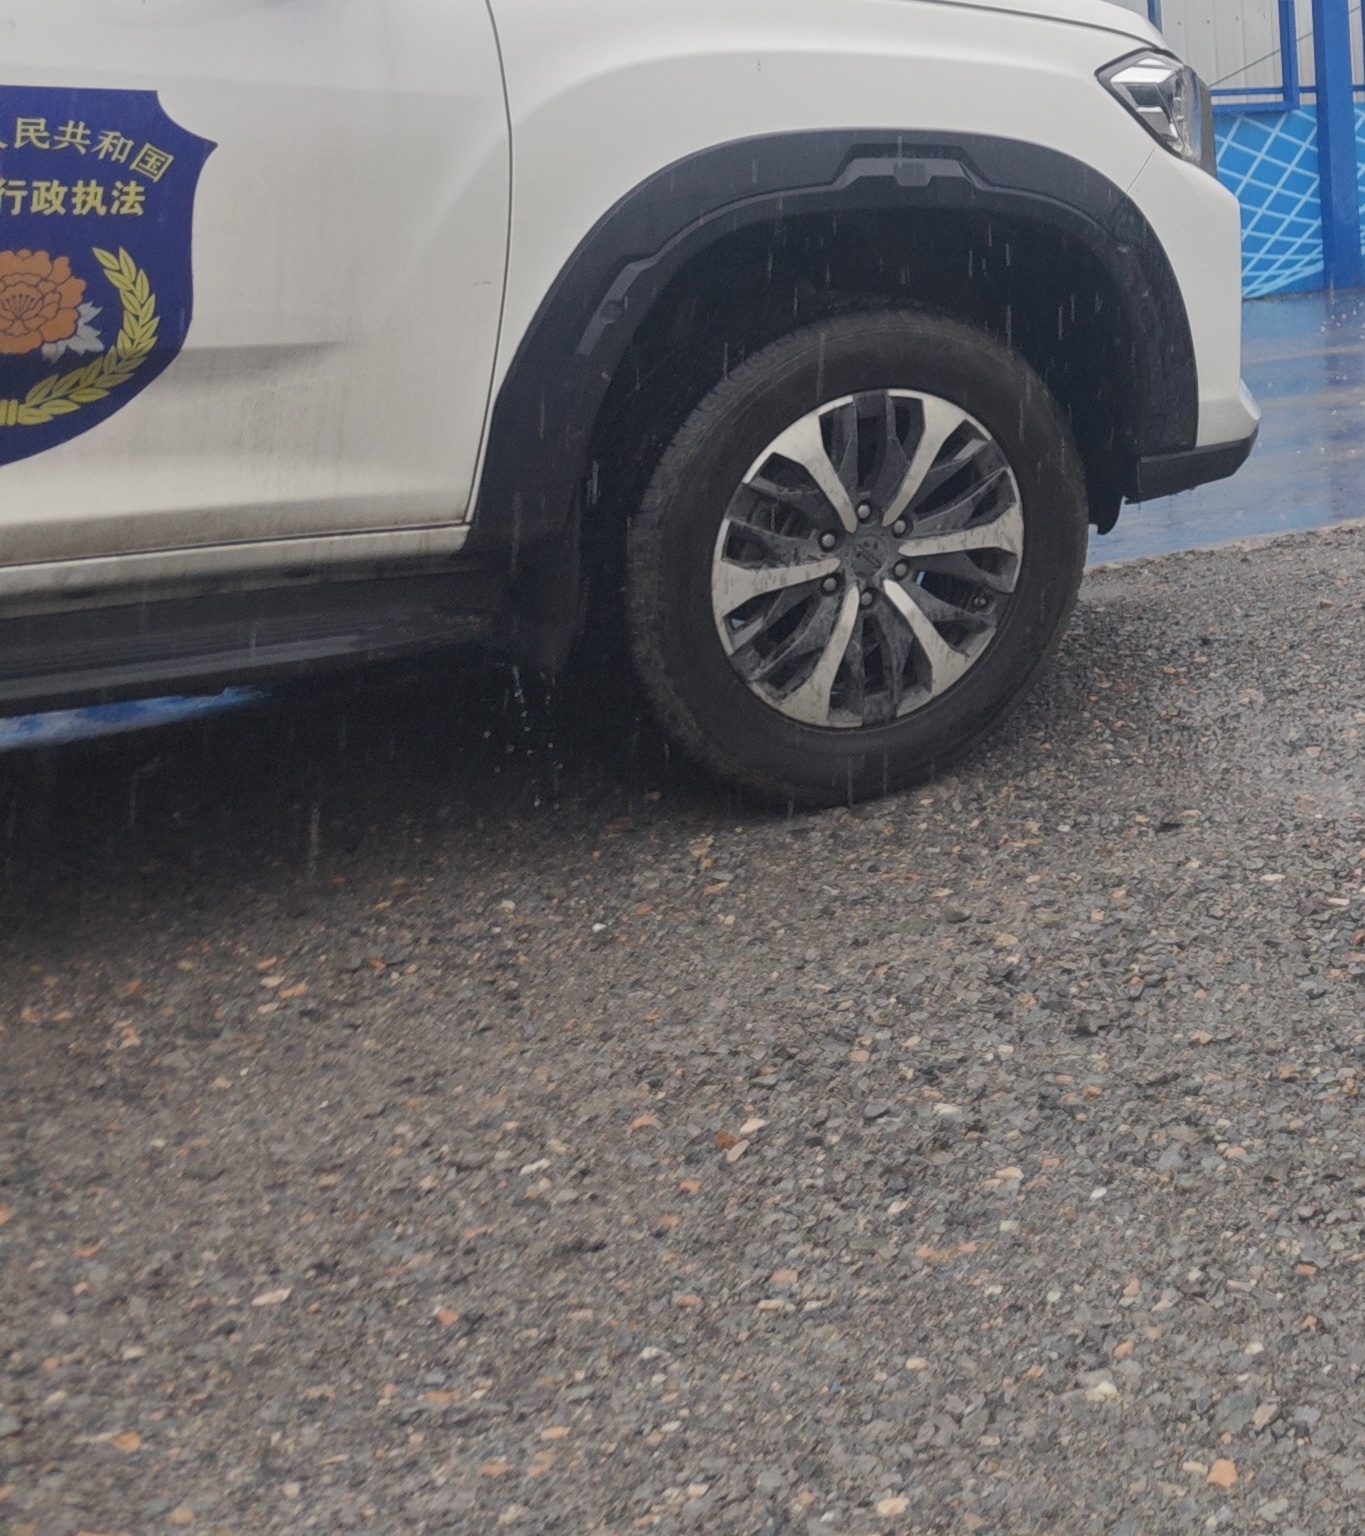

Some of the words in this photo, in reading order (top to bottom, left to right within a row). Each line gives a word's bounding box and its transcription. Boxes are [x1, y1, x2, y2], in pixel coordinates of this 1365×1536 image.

[0, 117, 174, 183] 民共和国
[0, 179, 146, 216] 行政执法
